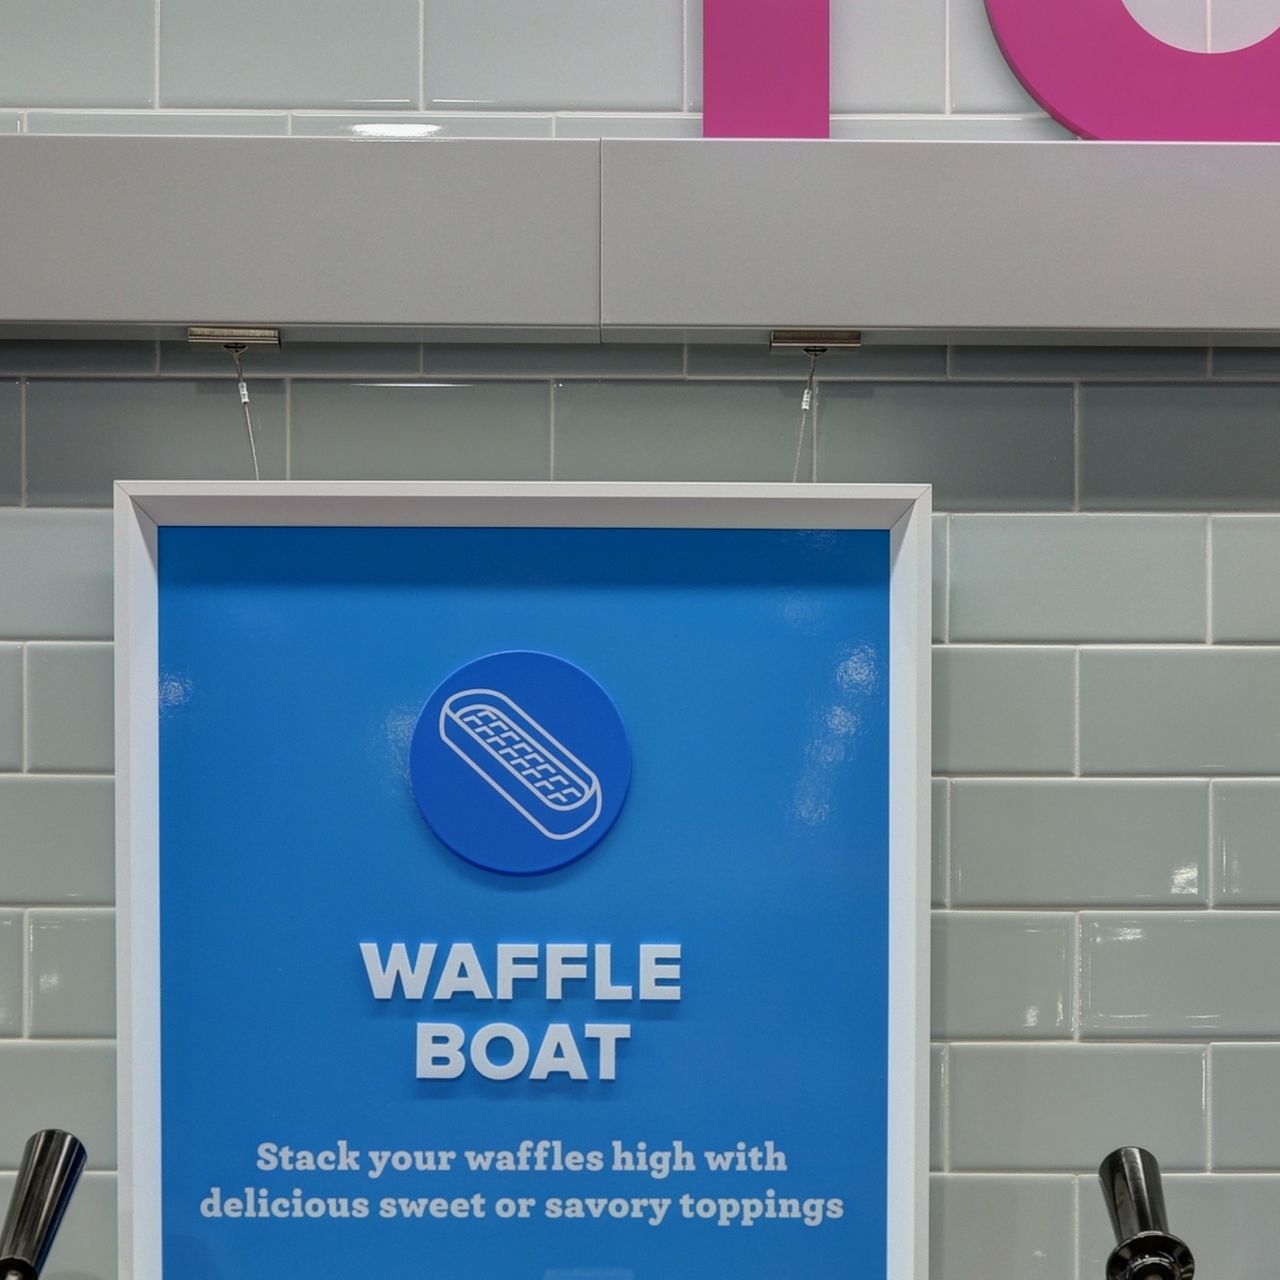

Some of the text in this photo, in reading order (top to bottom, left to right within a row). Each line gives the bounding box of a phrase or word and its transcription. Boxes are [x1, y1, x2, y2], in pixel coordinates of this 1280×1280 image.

[359, 942, 681, 1001] WAFFLE
[415, 1023, 631, 1081] BOAT
[256, 1141, 788, 1179] Stack your waffles high with
[199, 1188, 844, 1226] delicious sweet or savory toppings
